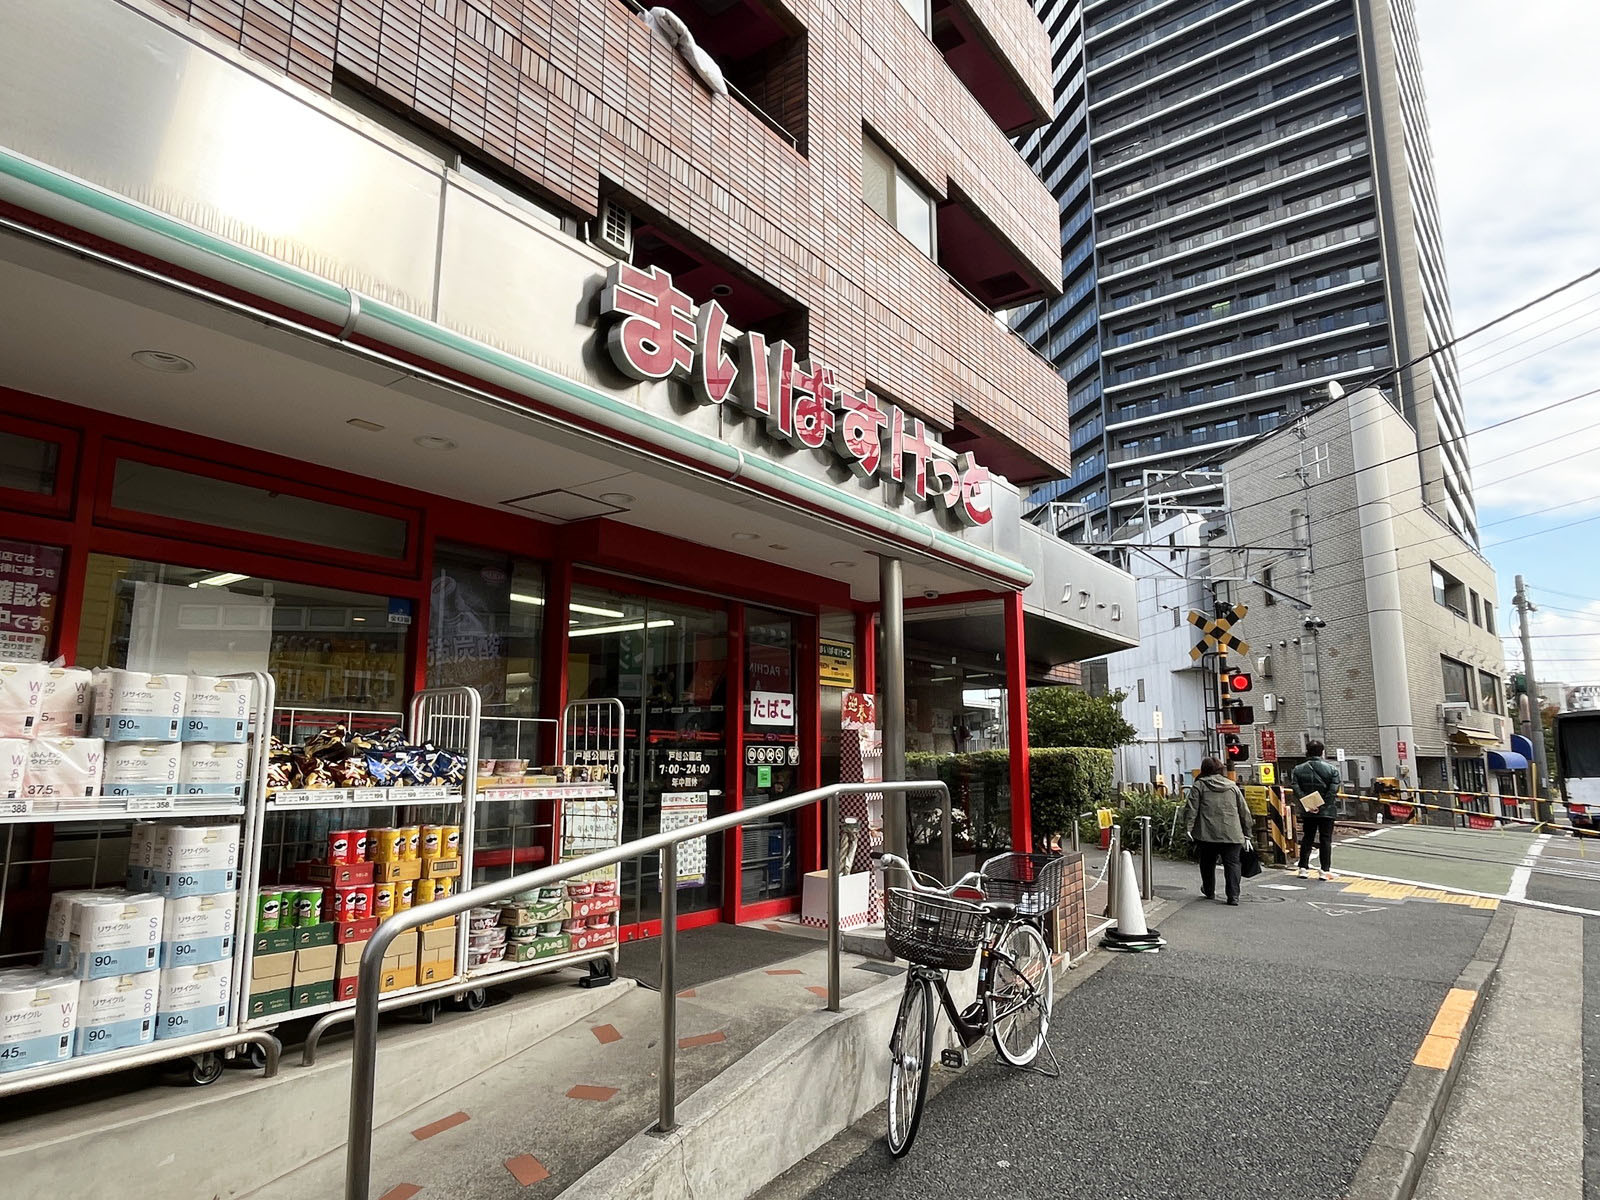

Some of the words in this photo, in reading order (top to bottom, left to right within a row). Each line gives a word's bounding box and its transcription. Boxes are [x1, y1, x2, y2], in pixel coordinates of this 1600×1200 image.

[603, 259, 993, 528] まいばすけっと
[122, 691, 154, 699] リサイクル
[753, 697, 792, 720] たばこ
[668, 751, 703, 762] 戸越公園店
[11, 804, 27, 813] 388
[180, 847, 211, 855] リサイクル
[178, 914, 209, 924] リサイクル
[97, 923, 132, 933] リサイクル
[170, 983, 202, 995] リサイクル
[92, 995, 126, 1008] リサイクル
[5, 1010, 43, 1023] リサイクル
